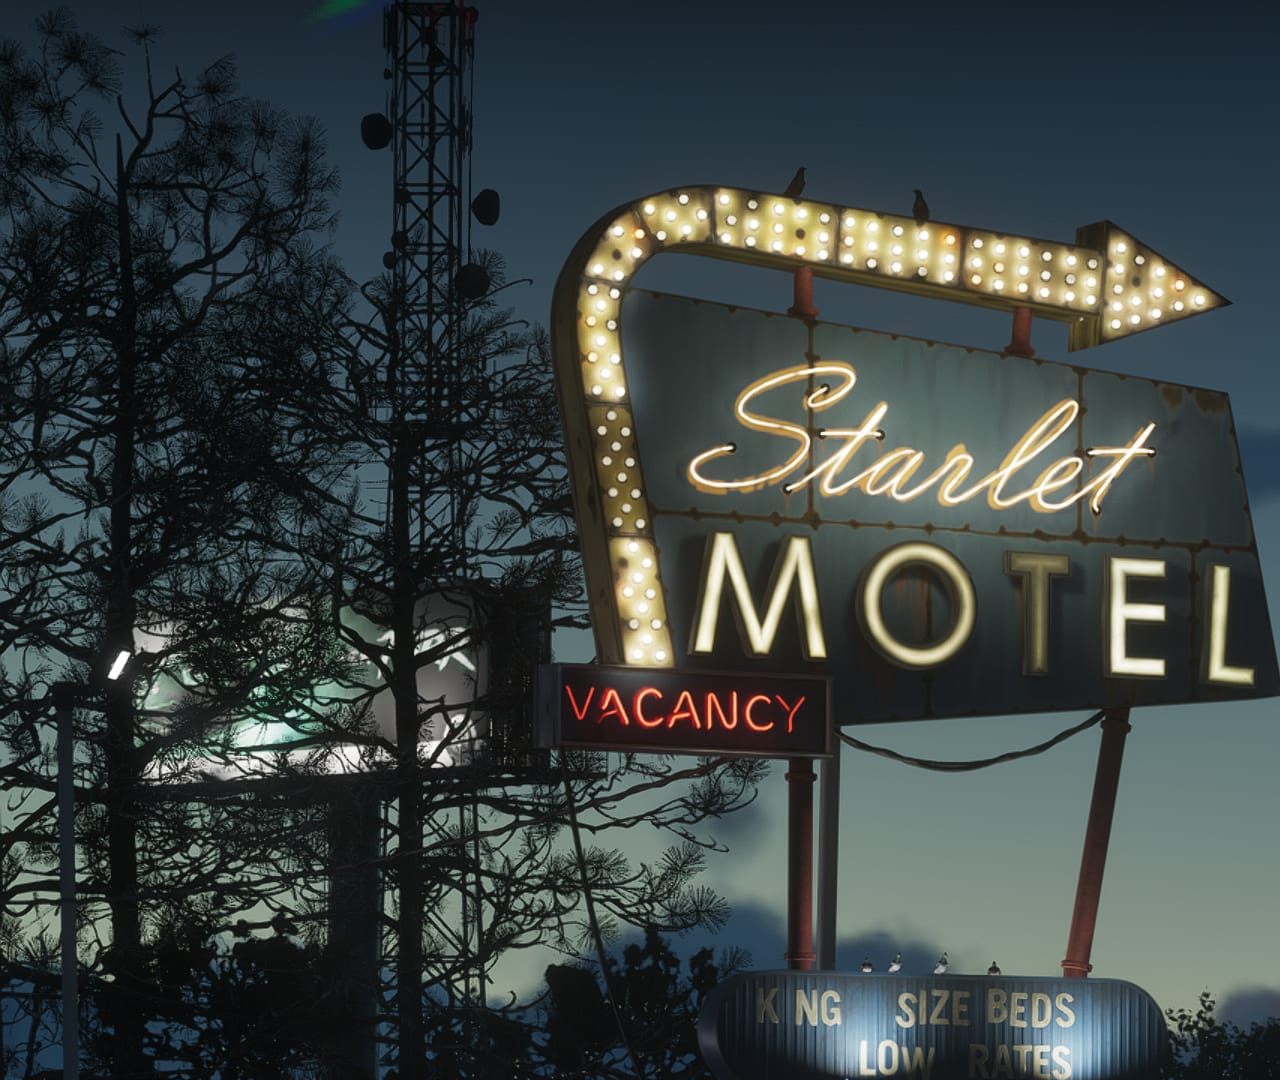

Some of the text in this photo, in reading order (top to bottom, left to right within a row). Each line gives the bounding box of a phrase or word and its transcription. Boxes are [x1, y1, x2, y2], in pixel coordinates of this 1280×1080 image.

[686, 359, 1157, 517] Starlet
[688, 530, 1258, 686] MOTEL
[565, 684, 807, 733] VACANCY
[895, 988, 971, 1029] SIZE
[988, 988, 1077, 1029] BEDS
[967, 1043, 1073, 1080] RATES
